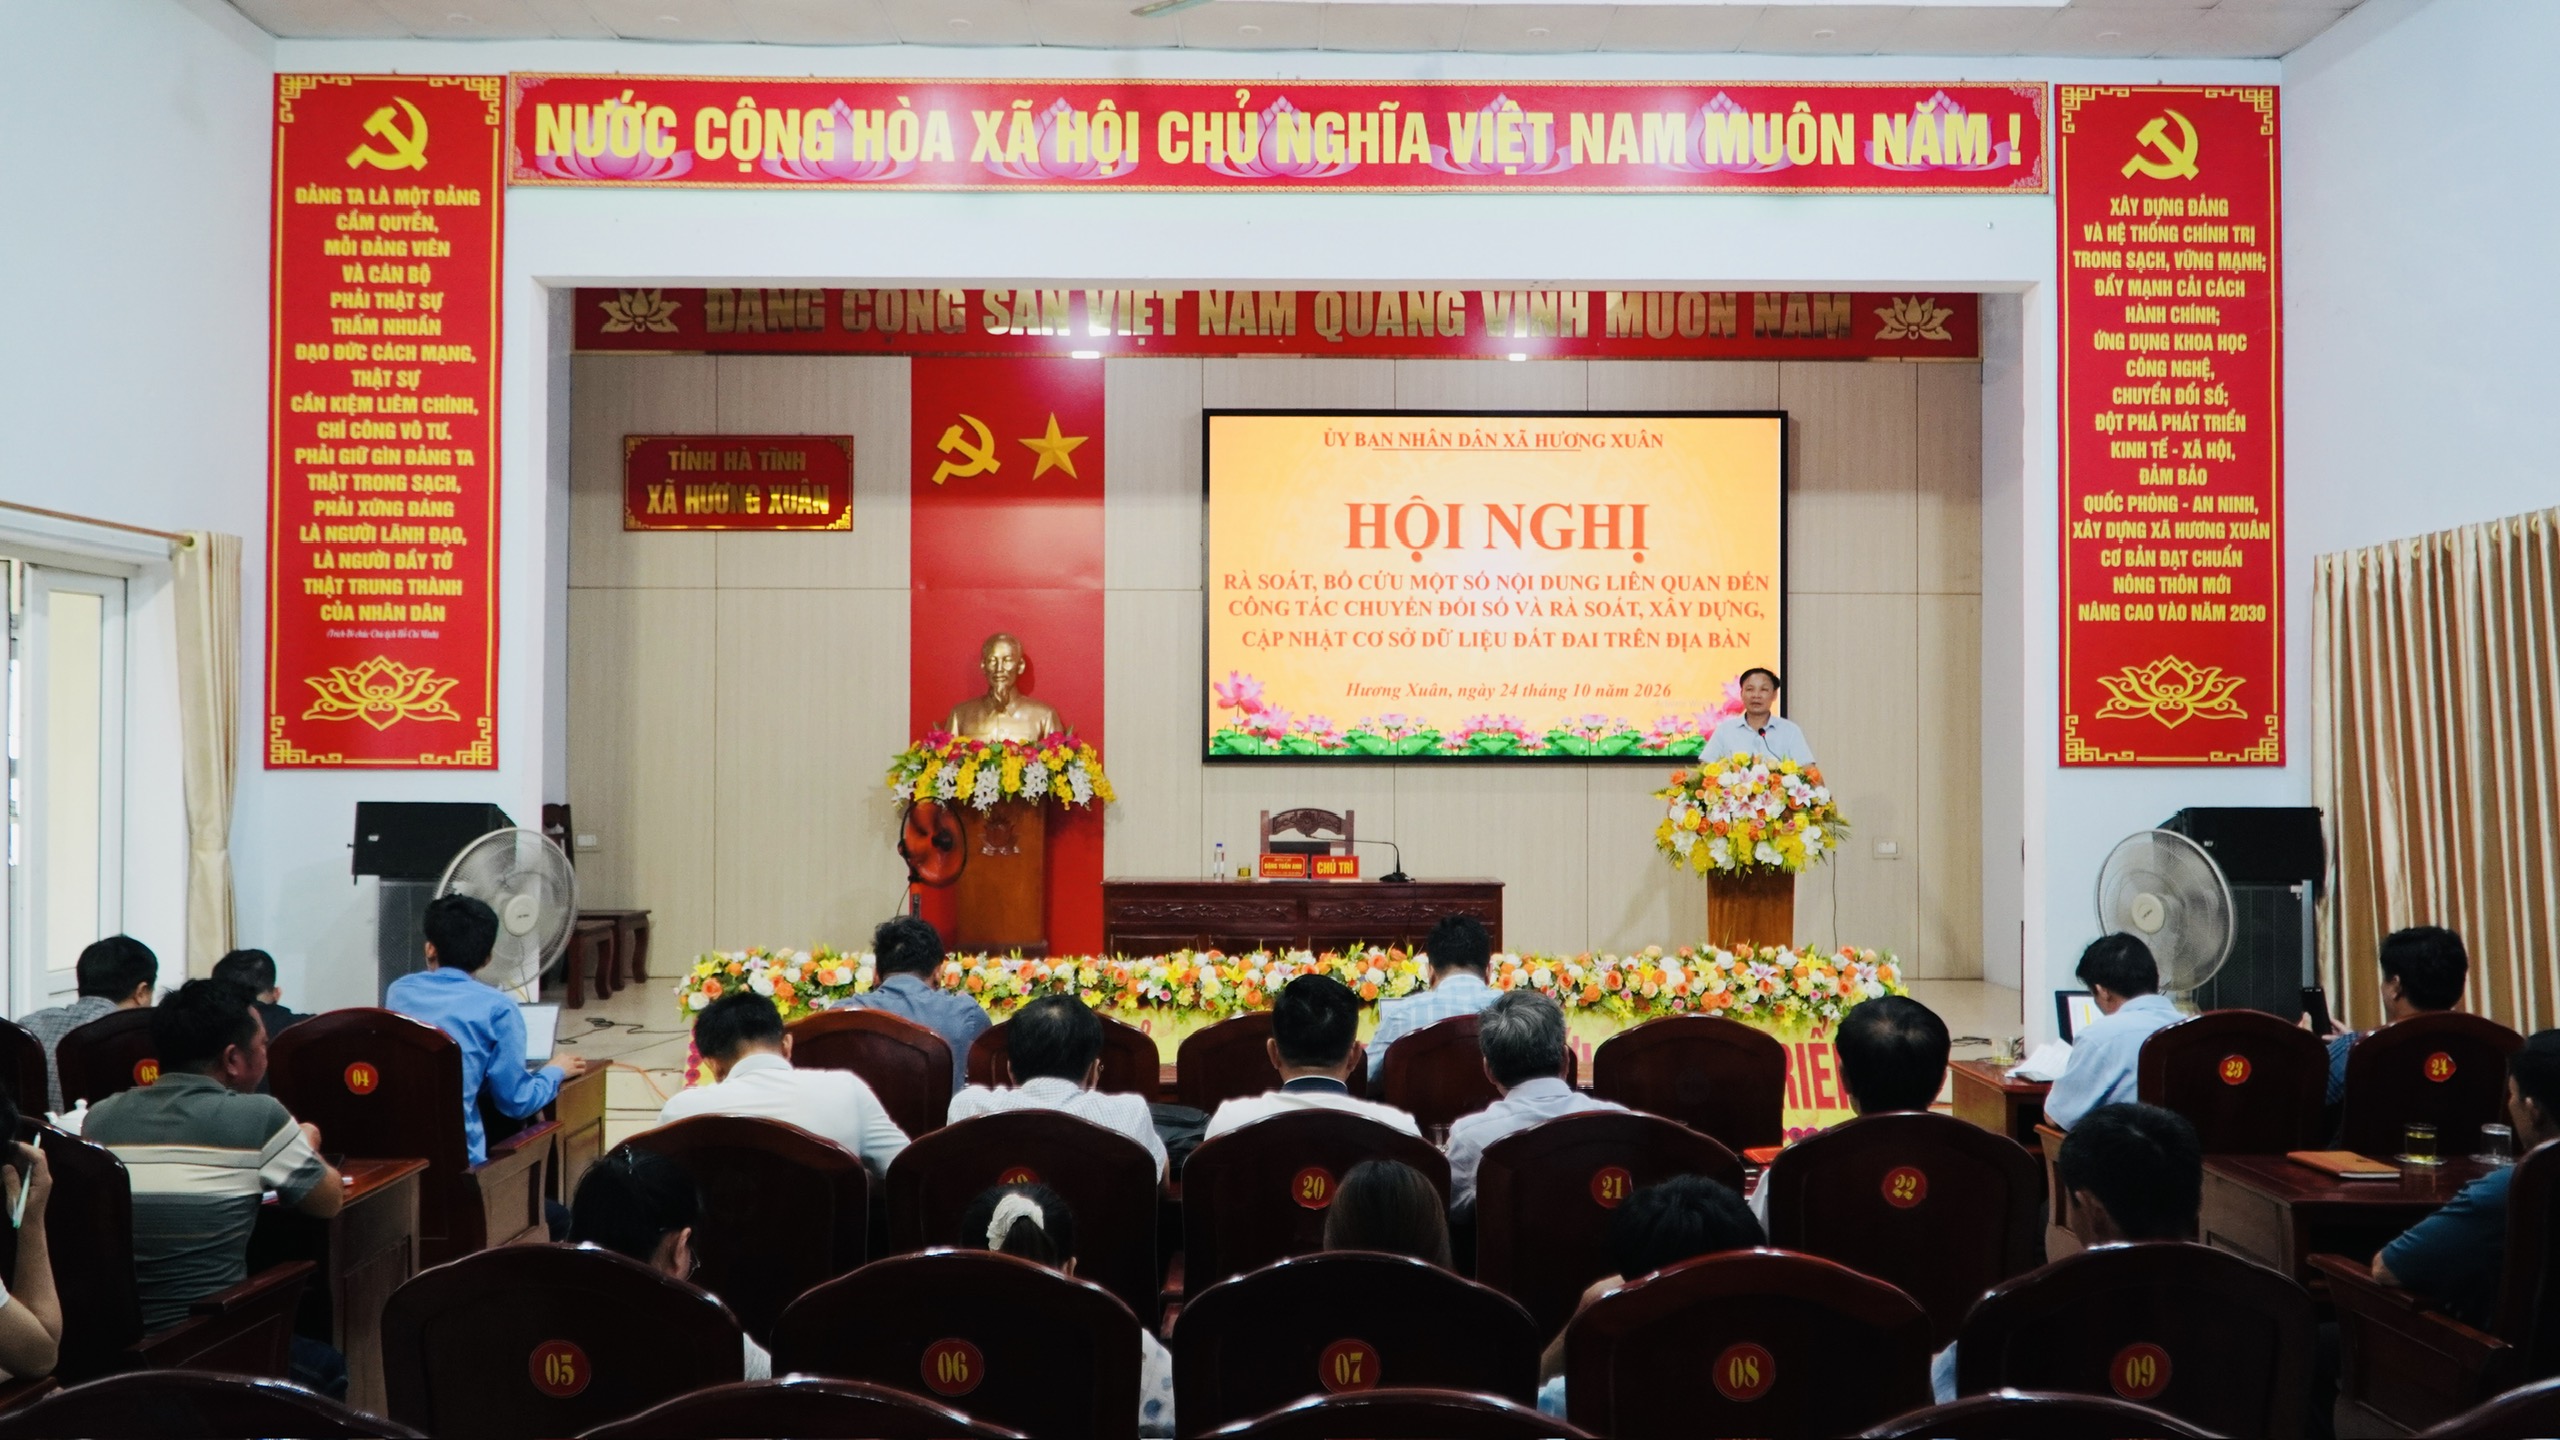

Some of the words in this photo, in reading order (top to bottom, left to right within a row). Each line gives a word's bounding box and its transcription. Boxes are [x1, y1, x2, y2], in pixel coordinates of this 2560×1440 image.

[536, 91, 676, 159] NƯỚC
[695, 98, 836, 172] CỘNG
[853, 94, 954, 163] HÒA
[970, 98, 1039, 164] XÃ
[1055, 99, 1139, 174] HỘI
[1158, 89, 1259, 164] CHỦ
[1276, 100, 1432, 164] NGHĨA
[1449, 100, 1555, 176] VIỆT
[1571, 113, 1687, 165] NAM
[1706, 100, 1856, 164] MUÔN
[1873, 102, 1987, 165] NĂM
[2007, 112, 2021, 165] !
[296, 184, 342, 204] ĐẢNG
[346, 188, 365, 207] TA
[369, 186, 390, 204] LÀ
[394, 186, 430, 210] MỘT
[434, 185, 480, 205] ĐẢNG
[2111, 195, 2139, 216] XÂY
[2144, 199, 2184, 221] DỰNG
[2188, 195, 2228, 216] ĐẢNG
[2084, 222, 2103, 242] VÀ
[2107, 222, 2126, 245] HỆ
[2130, 220, 2178, 242] THỐNG
[2183, 223, 2228, 242] CHÍNH
[2232, 226, 2255, 246] TRỊ
[343, 263, 364, 283] VÀ
[369, 263, 404, 283] CÁN
[408, 263, 431, 287] BỘ
[2095, 274, 2123, 296] ĐẨY
[2128, 279, 2172, 300] MẠNH
[2177, 275, 2201, 296] CẢI
[2206, 277, 2245, 297] CÁCH
[1198, 290, 1296, 337] NAM
[1314, 290, 1465, 340] QUANG
[1479, 291, 1589, 338] VINH
[2094, 330, 2125, 350] ỨNG
[2129, 333, 2170, 354] DỤNG
[2174, 334, 2213, 351] KHOA
[2218, 334, 2247, 354] HỌC
[2095, 411, 2123, 435] ĐỘT
[2128, 411, 2158, 431] PHÁ
[2162, 411, 2199, 431] PHÁT
[2203, 409, 2246, 432] TRIỂN
[1325, 428, 1349, 446] ỦY
[1356, 432, 1392, 448] BAN
[1400, 429, 1451, 448] NHÂN
[1459, 429, 1496, 448] DÂN
[1504, 430, 1528, 448] XÃ
[1536, 430, 1605, 448] HƯƠNG
[1612, 429, 1662, 448] XUÂN
[668, 443, 717, 472] TỈNH
[722, 445, 752, 472] HÀ
[308, 471, 348, 496] THẬT
[352, 474, 407, 491] TRONG
[411, 474, 461, 495] SẠCH,
[2139, 464, 2173, 485] ĐẢM
[2178, 464, 2207, 485] BẢO
[646, 481, 677, 514] XÃ
[684, 484, 760, 514] HƯƠNG
[768, 481, 830, 515] XUÂN
[1344, 495, 1463, 562] HỘI
[1484, 503, 1649, 562] NGHỊ
[2073, 519, 2101, 538] XÂY
[2106, 522, 2146, 543] DỰNG
[2151, 519, 2171, 538] XÃ
[2175, 522, 2225, 539] HƯƠNG
[2230, 519, 2270, 541] XUÂN
[2101, 550, 2121, 567] CƠ
[2125, 546, 2156, 567] BẢN
[2160, 550, 2188, 570] ĐẠT
[2192, 545, 2242, 567] CHUẨN
[304, 576, 344, 600] THẬT
[348, 579, 403, 595] TRUNG
[407, 576, 462, 595] THÀNH
[1225, 570, 1251, 589] RÀ
[1259, 570, 1317, 591] SOÁT,
[1411, 573, 1458, 594] MỘT
[1497, 573, 1533, 594] NỘI
[1541, 576, 1599, 590] DUNG
[1607, 571, 1654, 590] LIÊN
[1661, 576, 1720, 594] QUAN
[2113, 573, 2155, 593] NÔNG
[2159, 574, 2198, 594] THÔN
[2203, 574, 2231, 594] MỚI
[321, 600, 354, 620] CỦA
[359, 602, 406, 621] NHÂN
[410, 602, 445, 622] DÂN
[1229, 596, 1289, 616] CÔNG
[1296, 596, 1337, 616] TÁC
[1516, 597, 1542, 616] VÀ
[1551, 597, 1577, 616] RÀ
[1585, 598, 1643, 618] SOÁT,
[1650, 597, 1692, 616] XÂY
[1699, 600, 1764, 621] DỰNG,
[2079, 601, 2120, 621] NÂNG
[2125, 604, 2153, 621] CAO
[2158, 601, 2187, 621] VÀO
[2191, 602, 2225, 621] NĂM
[2230, 605, 2265, 621] 2030
[1353, 631, 1383, 646] CƠ
[1389, 628, 1416, 646] SỞ
[1423, 628, 1453, 647] DỮ
[1459, 632, 1506, 651] LIỆU
[1563, 632, 1597, 647] ĐAI
[1604, 628, 1659, 647] TRÊN
[1667, 633, 1702, 652] ĐỊA
[1709, 628, 1749, 647] BÀN
[1347, 683, 1401, 699] Hương
[1407, 683, 1452, 697] Xuân,
[1458, 684, 1495, 700] ngày
[1501, 684, 1518, 696] 24
[1523, 684, 1567, 700] tháng
[1574, 684, 1590, 696] 10
[1596, 685, 1628, 697] năm
[1635, 684, 1671, 697] 2026
[1317, 858, 1336, 874] CHỦ
[1339, 860, 1353, 874] TRÌ
[141, 1066, 158, 1083] 03
[352, 1069, 370, 1088] 04
[2226, 1060, 2244, 1079] 23
[2431, 1058, 2448, 1077] 24
[1302, 1175, 1325, 1200] 20
[1602, 1176, 1624, 1199] 21
[1893, 1175, 1917, 1200] 22
[545, 1354, 574, 1387] 05
[937, 1352, 968, 1383] 06
[1335, 1352, 1363, 1384] 07
[1728, 1356, 1759, 1388] 08
[2125, 1356, 2155, 1388] 09
